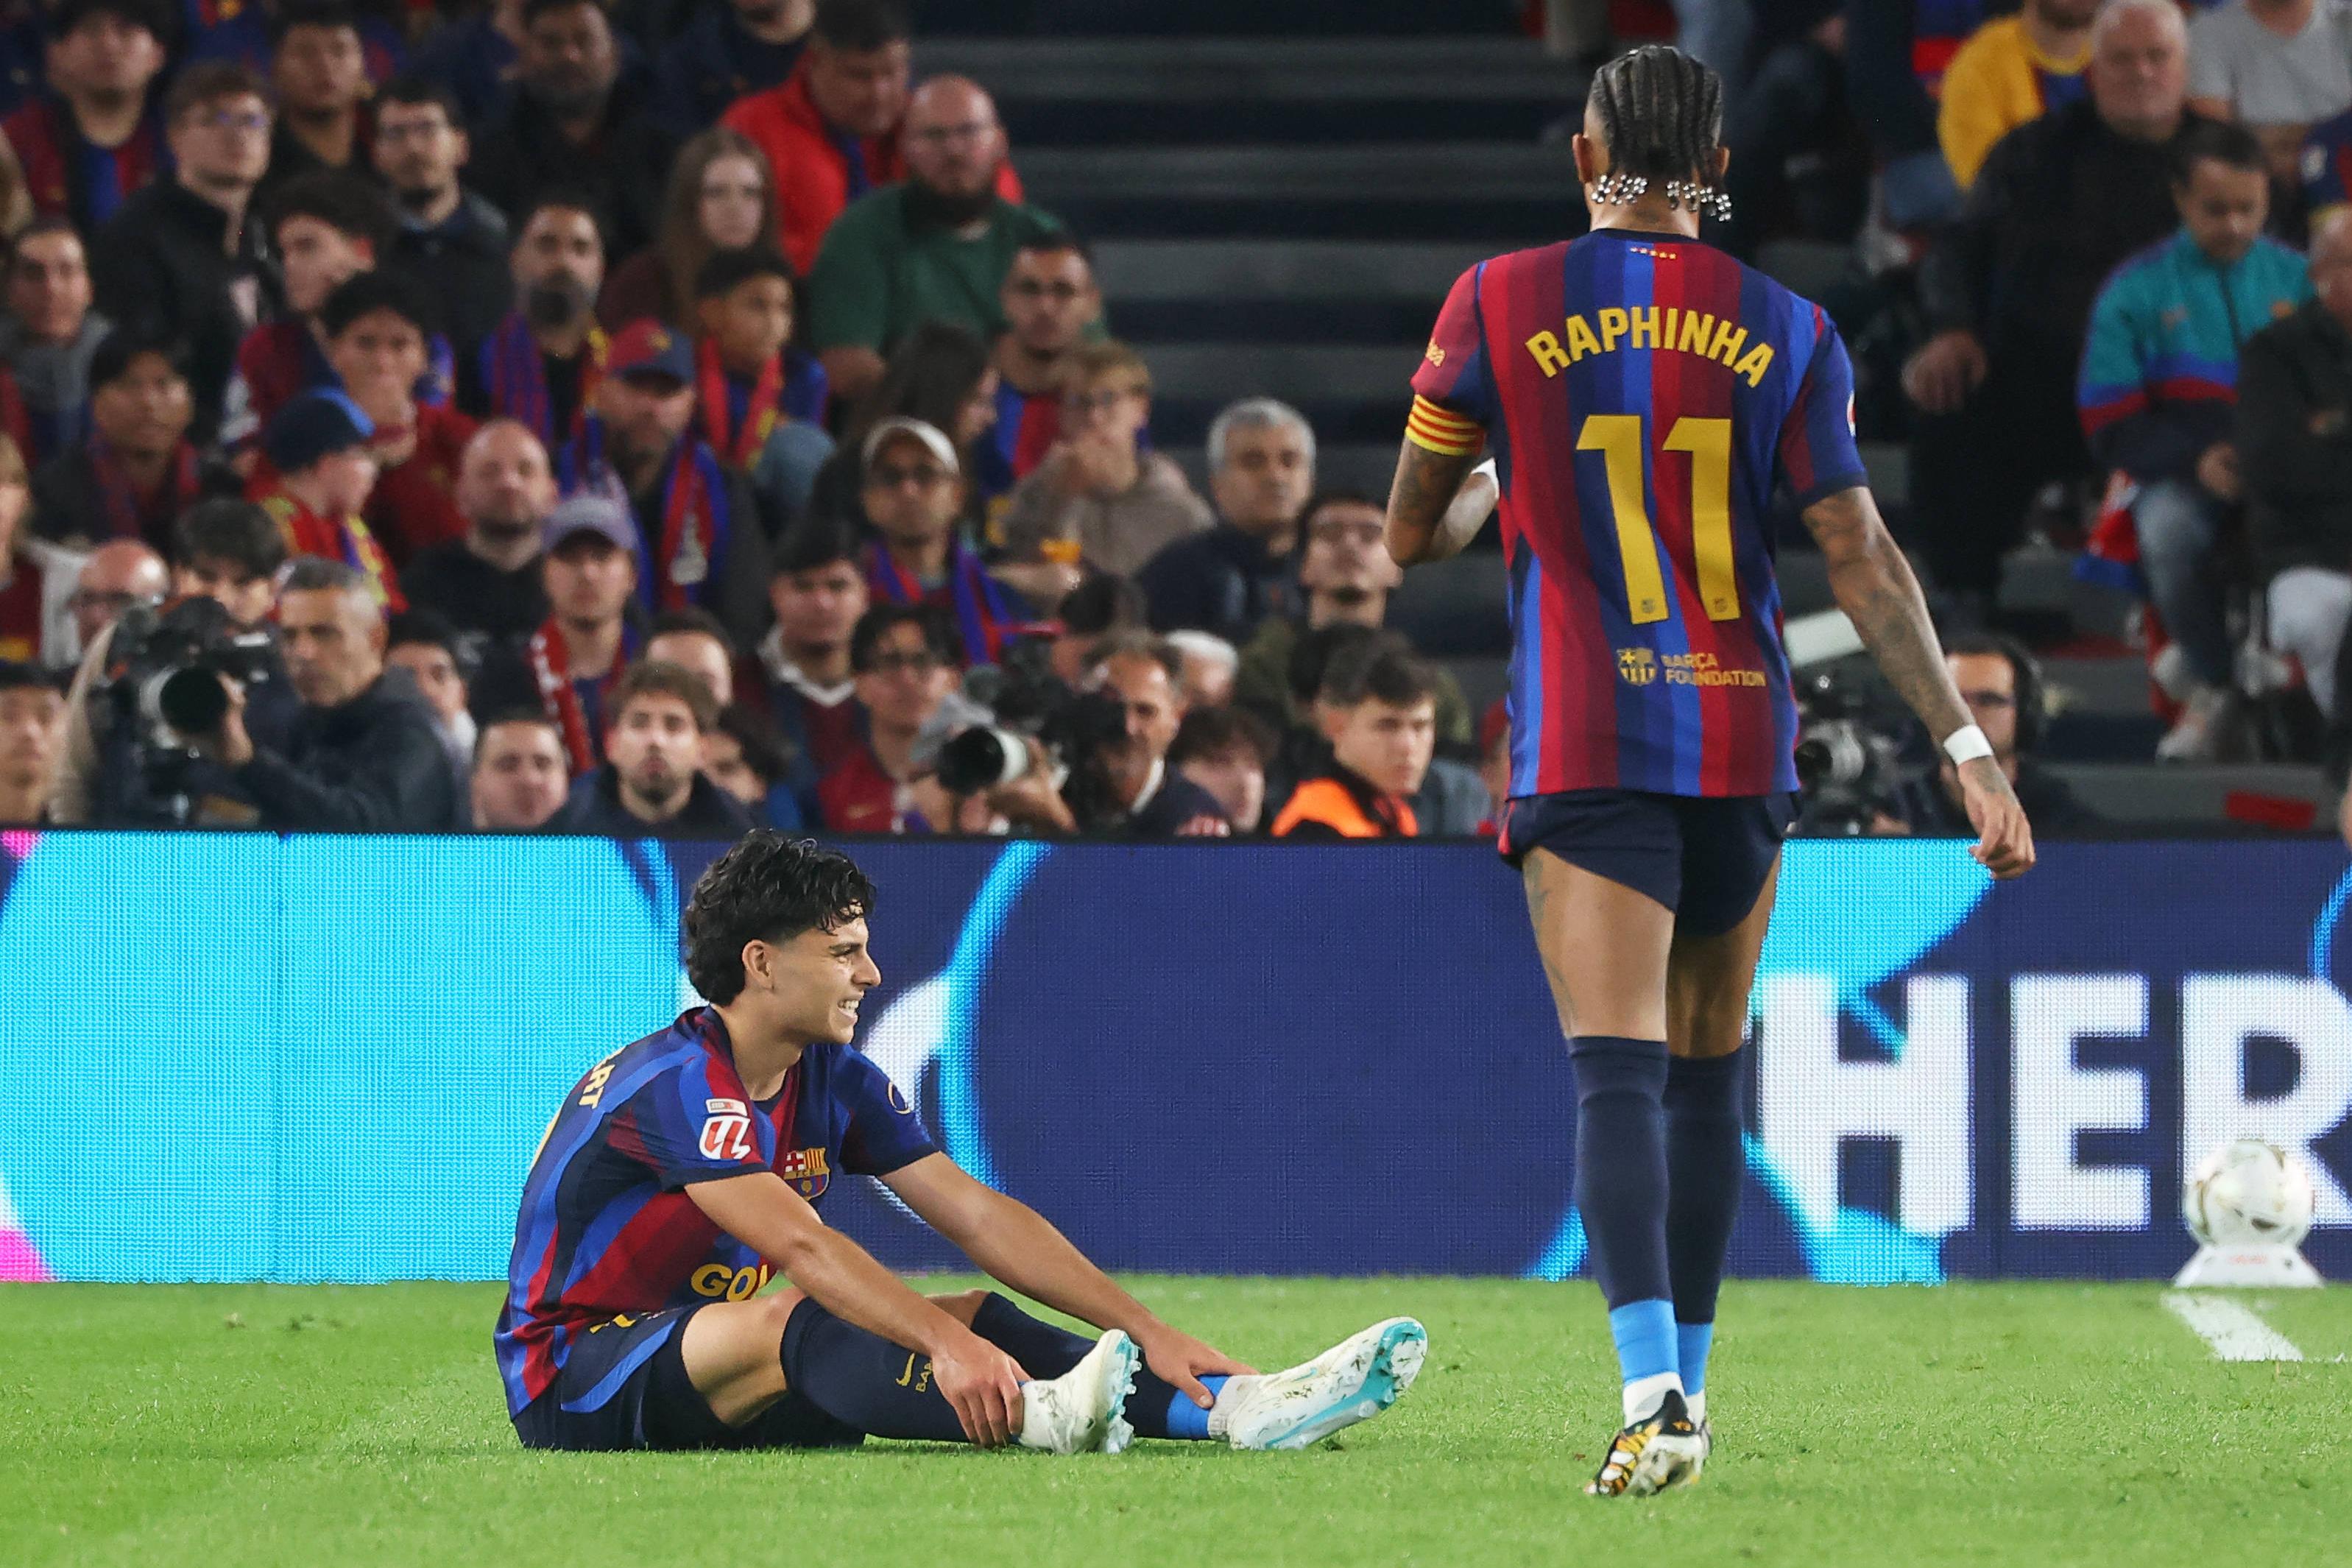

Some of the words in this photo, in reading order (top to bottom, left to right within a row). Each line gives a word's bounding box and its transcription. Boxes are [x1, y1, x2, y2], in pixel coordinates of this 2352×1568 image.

[1525, 306, 1775, 388] RAPHINHA
[1576, 414, 1741, 625] 11
[1665, 669, 1766, 687] FOUNDATION
